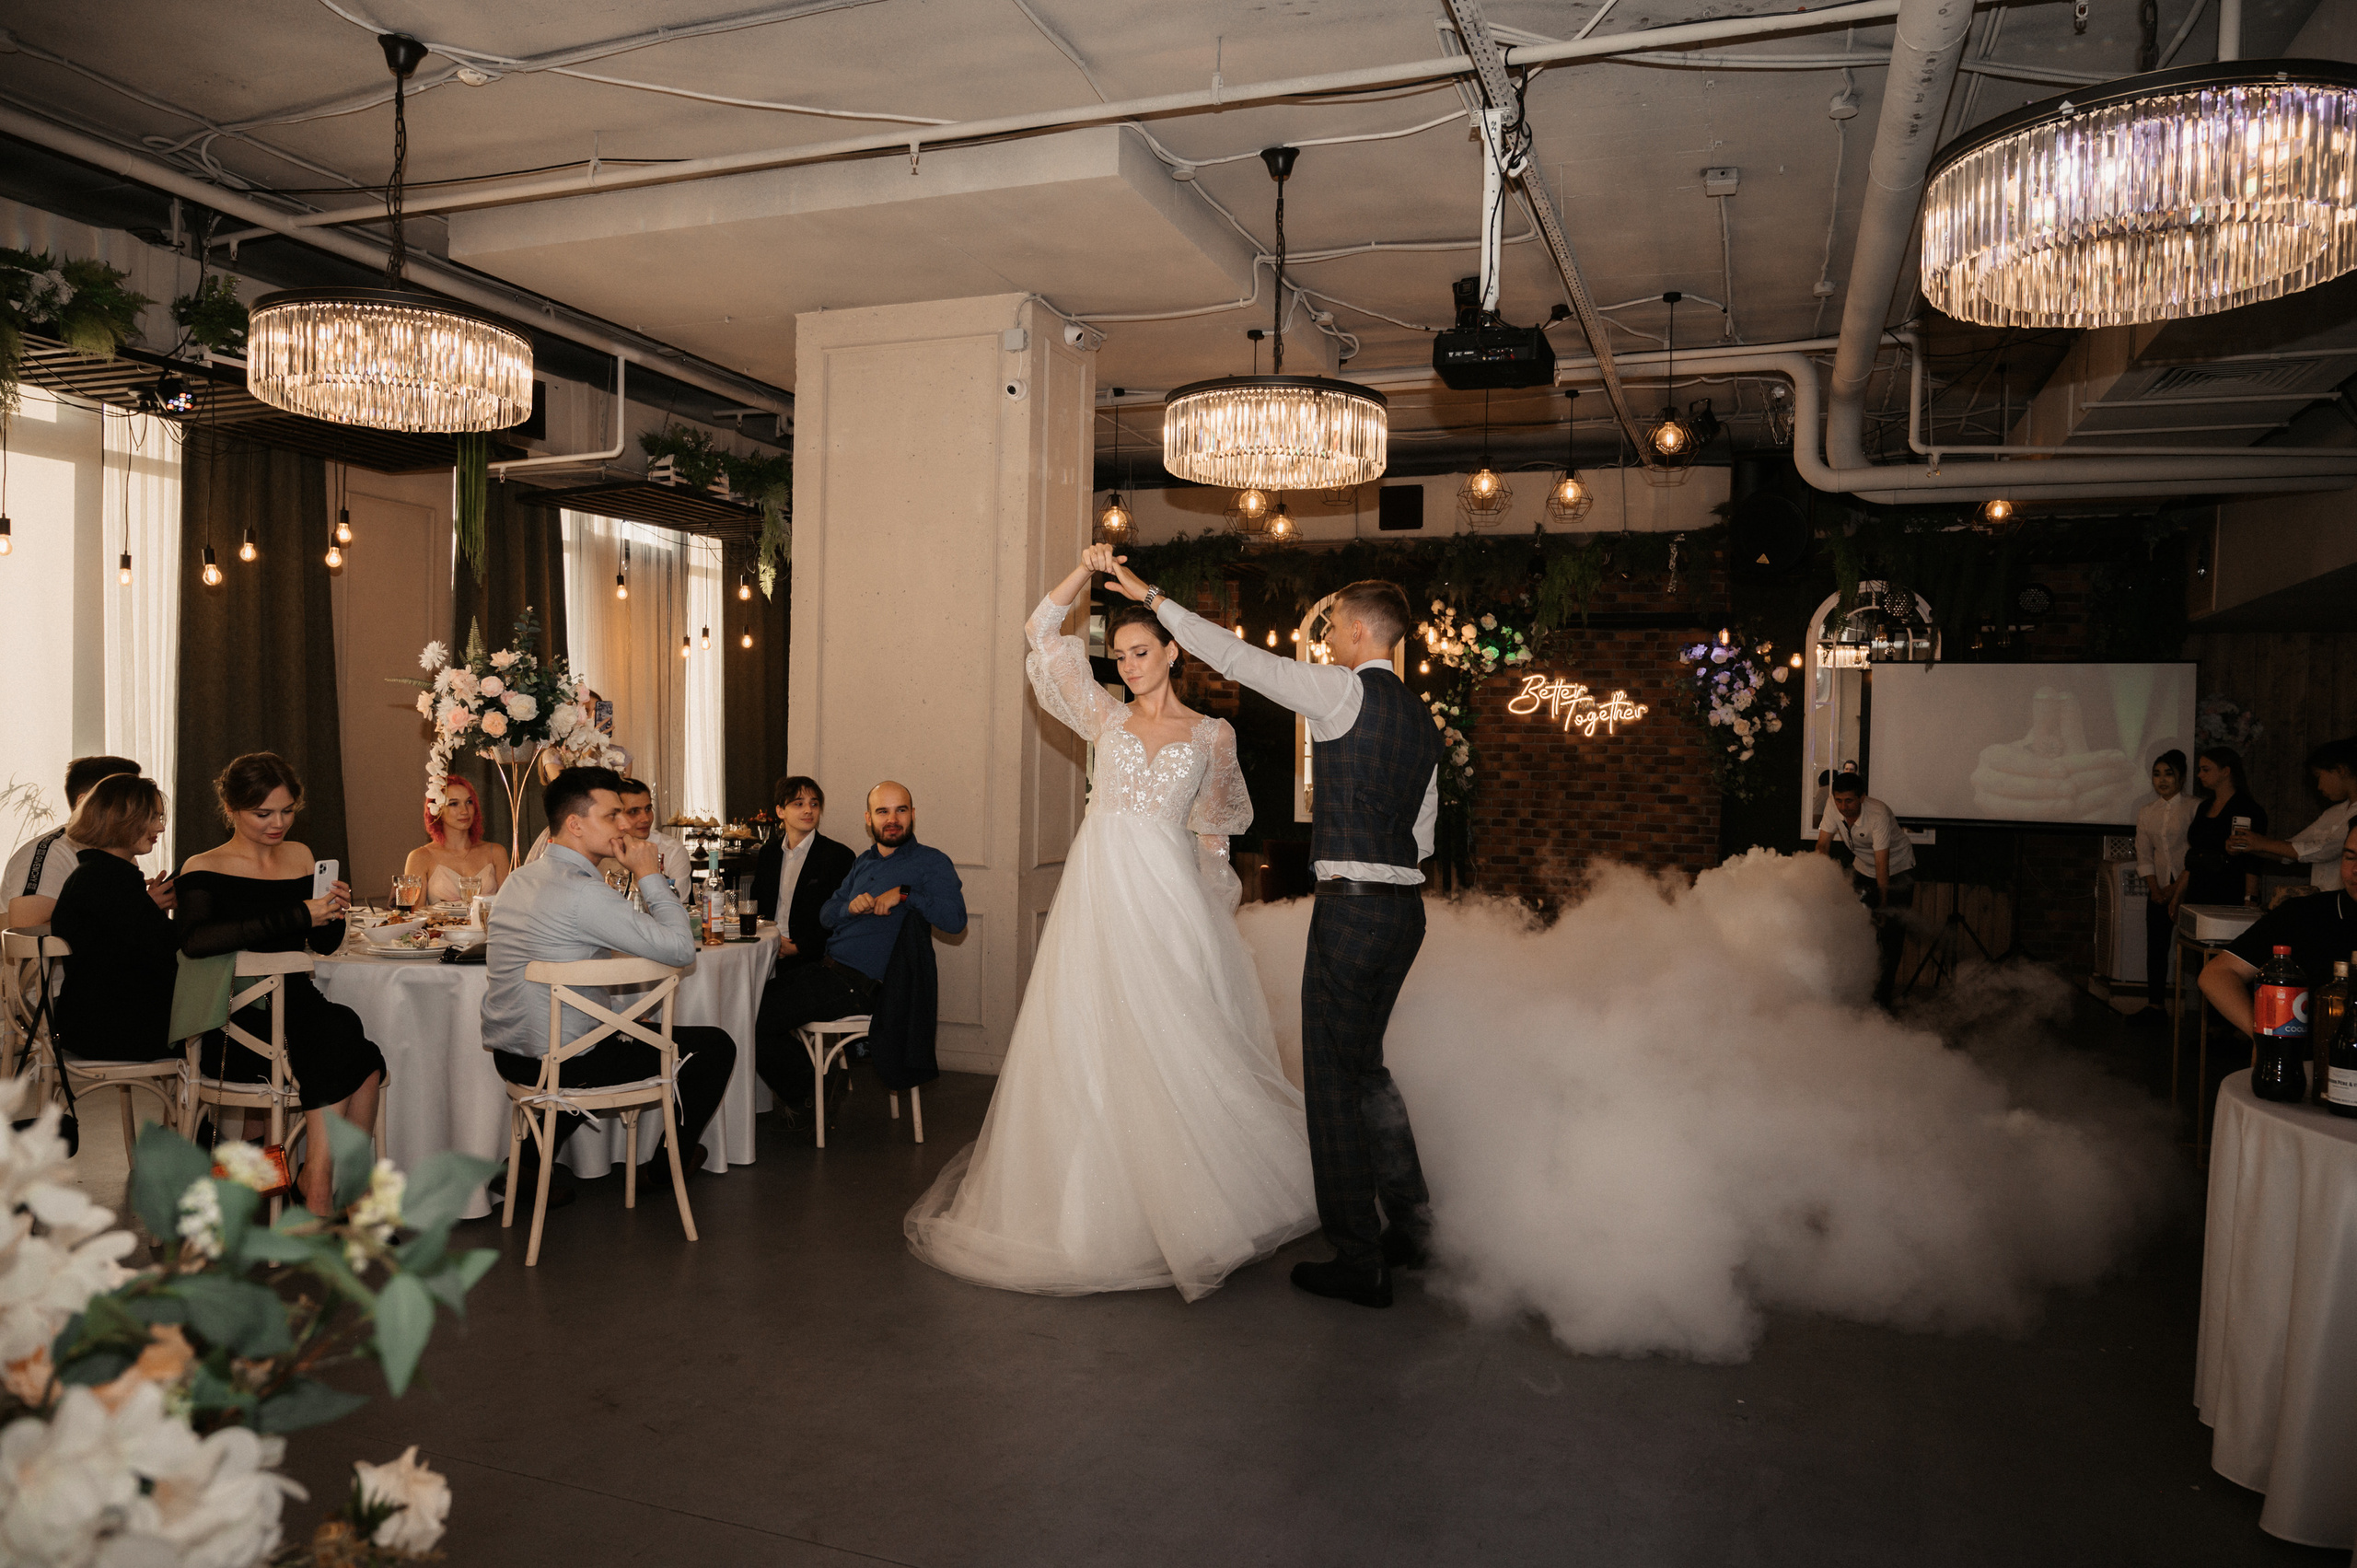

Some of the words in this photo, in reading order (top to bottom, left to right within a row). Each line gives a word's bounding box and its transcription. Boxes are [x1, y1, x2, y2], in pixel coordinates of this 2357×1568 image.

[1507, 674, 1588, 719] Better
[1560, 688, 1649, 738] Together
[29, 855, 43, 884] GIVENCHY
